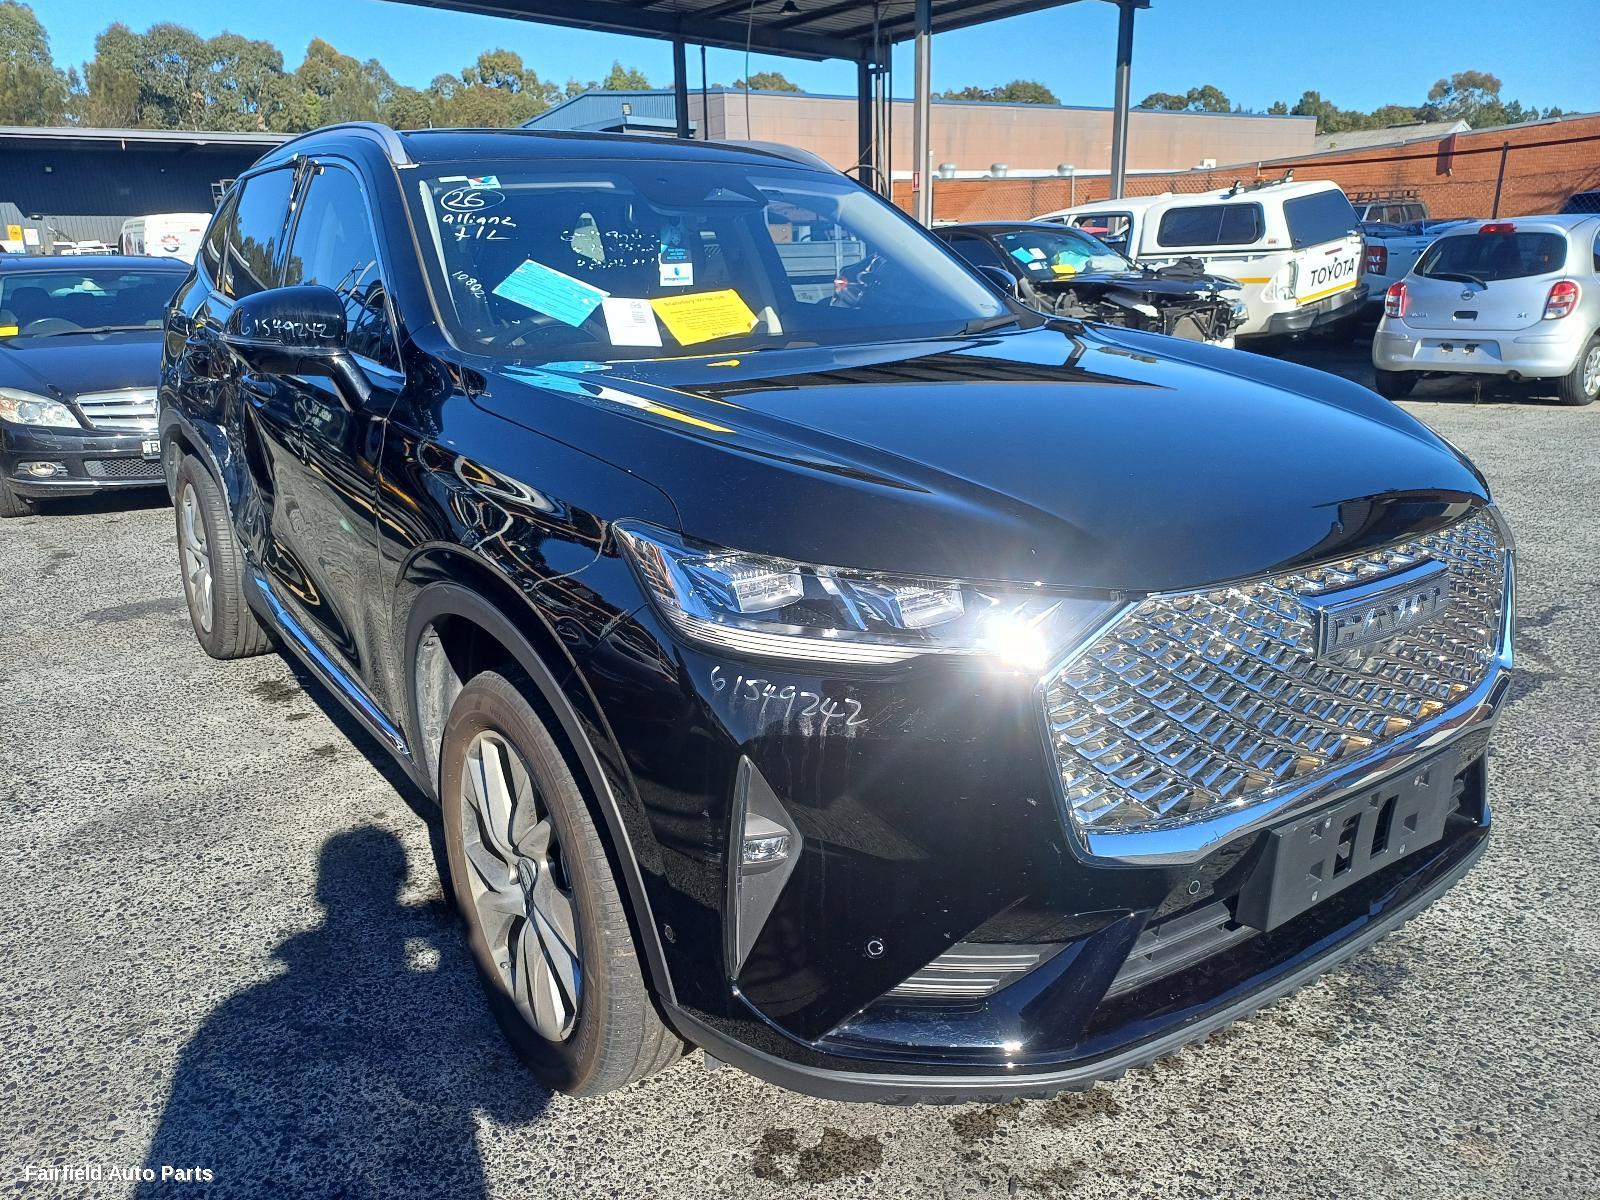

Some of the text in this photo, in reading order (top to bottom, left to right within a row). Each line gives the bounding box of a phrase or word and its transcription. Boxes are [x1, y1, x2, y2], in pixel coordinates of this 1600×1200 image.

[447, 191, 485, 207] 26
[1310, 257, 1355, 287] TOYOTA
[240, 313, 336, 339] 61549242
[1334, 586, 1447, 647] HAVAL
[710, 665, 869, 731] 61549242
